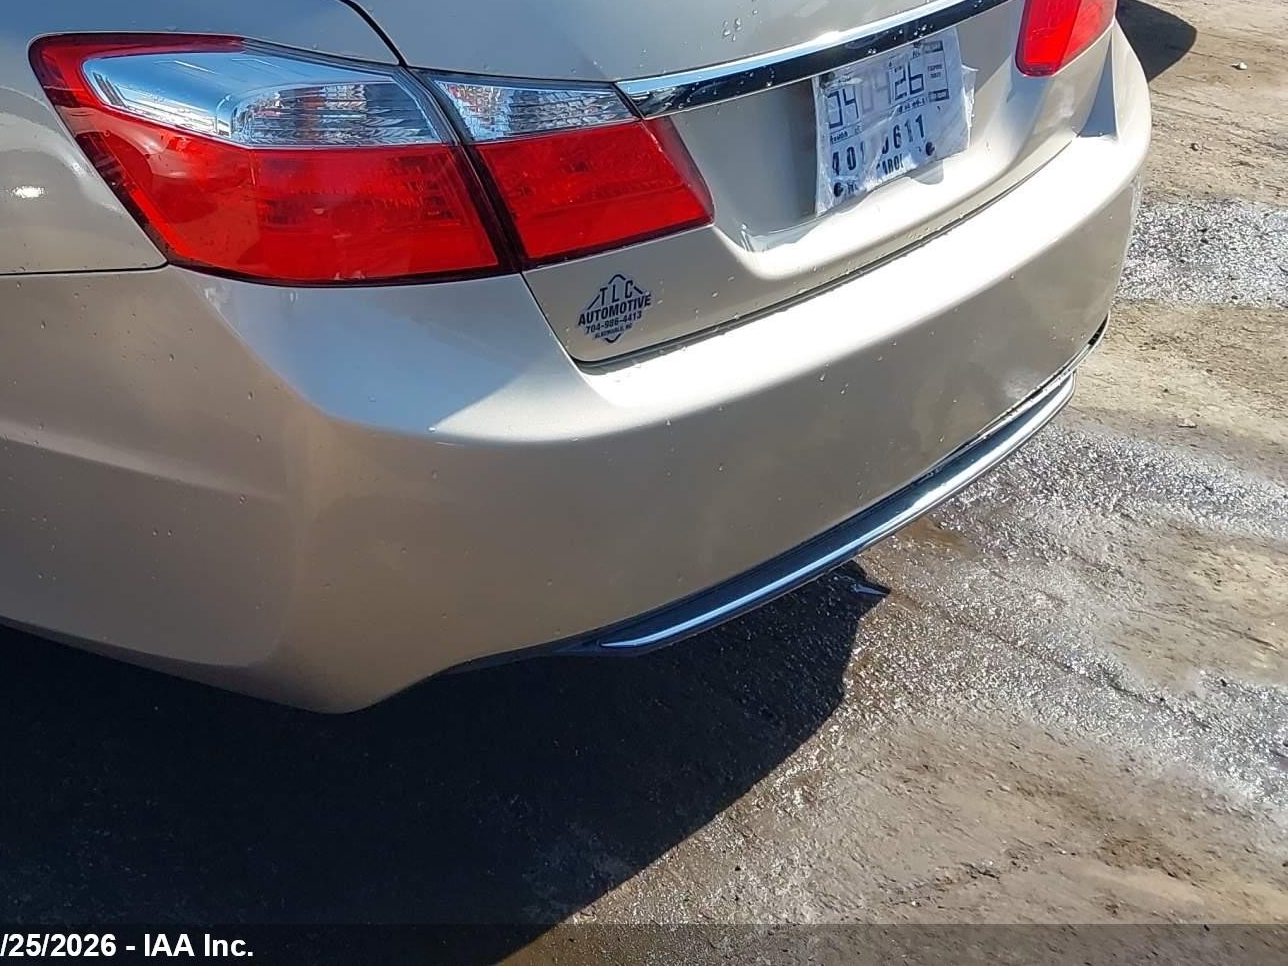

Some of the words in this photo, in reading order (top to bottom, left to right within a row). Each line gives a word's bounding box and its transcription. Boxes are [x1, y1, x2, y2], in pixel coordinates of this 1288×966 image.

[893, 63, 925, 102] 26
[578, 293, 652, 326] AUTOMOTIVE
[600, 280, 633, 306] TLC
